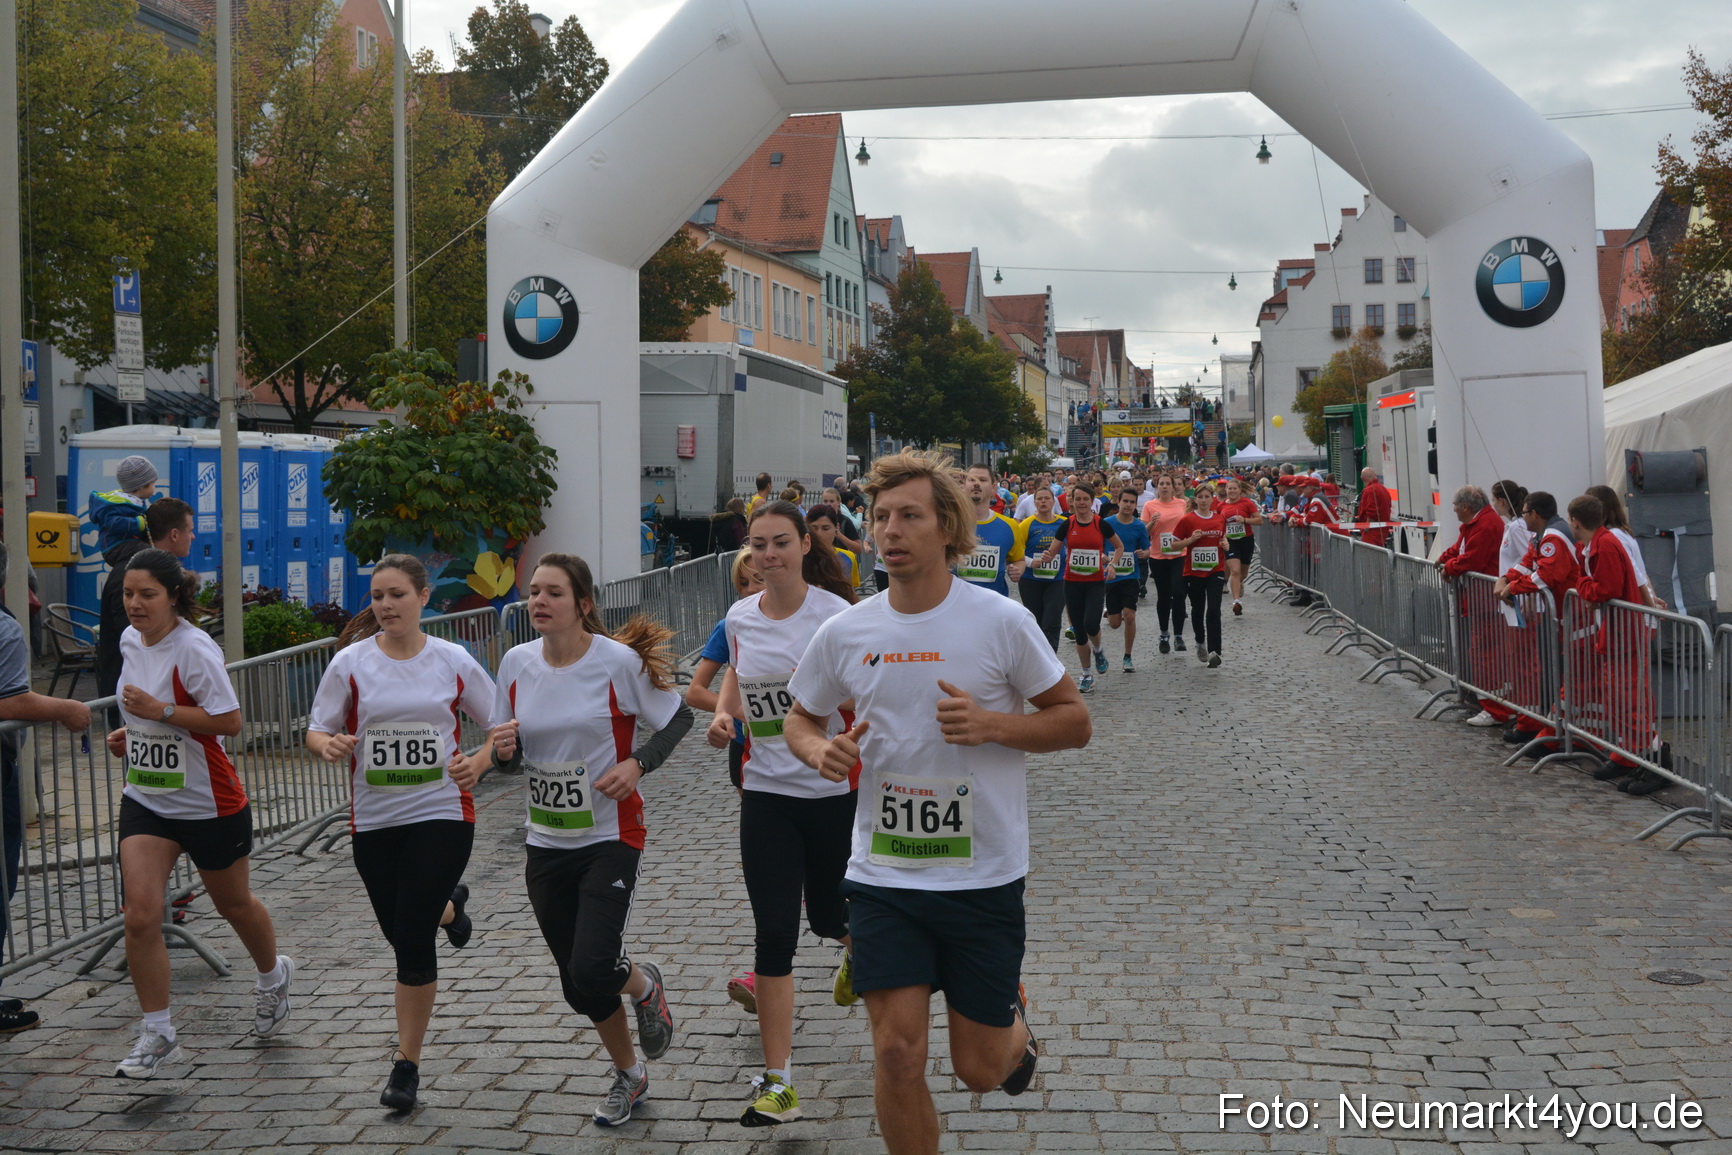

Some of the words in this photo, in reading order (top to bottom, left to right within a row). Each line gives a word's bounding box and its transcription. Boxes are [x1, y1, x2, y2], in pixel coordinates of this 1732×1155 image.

[1482, 238, 1559, 270] BMW
[508, 277, 573, 306] BMW
[59, 425, 68, 445] 3
[1131, 426, 1162, 434] START
[198, 467, 216, 493] DIXI
[242, 464, 259, 492] DIXI
[288, 465, 308, 491] DIXI
[1227, 525, 1244, 534] 5106
[1162, 537, 1172, 547] 51
[1072, 555, 1096, 566] 5011
[1111, 557, 1133, 567] 176
[1194, 552, 1217, 562] 5050
[1037, 559, 1058, 570] 010
[967, 569, 989, 577] Michael
[883, 652, 946, 663] KLEBL
[746, 690, 793, 718] 519
[127, 729, 142, 738] PARTL
[142, 732, 172, 740] Neumarkt
[367, 729, 391, 737] PARTL
[392, 728, 431, 737] Neumarkt
[131, 740, 179, 769] 5206
[372, 739, 438, 767] 5185
[386, 772, 423, 784] Marina
[540, 769, 573, 777] Neumarkt
[138, 773, 166, 786] Nadine
[529, 776, 584, 808] 5225
[893, 785, 938, 797] KLEBL
[546, 813, 564, 827] Lisa
[881, 795, 963, 833] 5164
[891, 839, 949, 856] Christian
